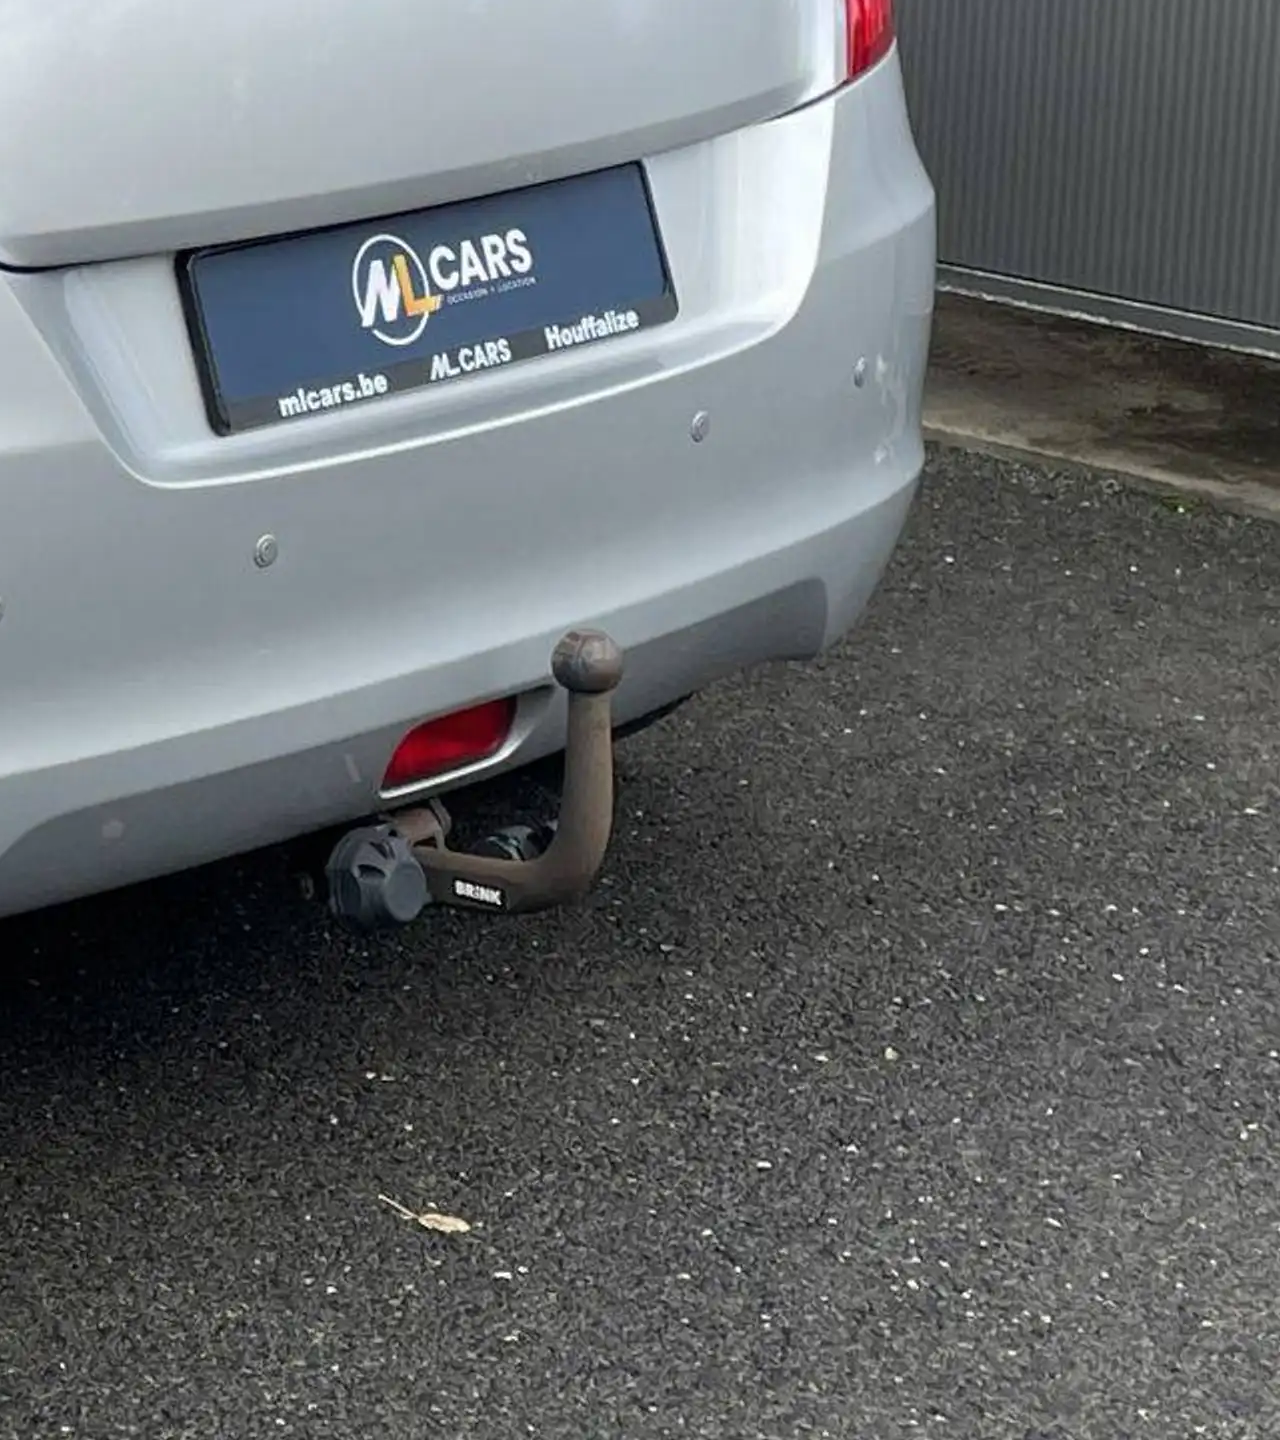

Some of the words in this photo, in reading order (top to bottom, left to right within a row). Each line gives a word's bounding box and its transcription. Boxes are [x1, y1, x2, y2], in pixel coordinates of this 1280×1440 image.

[361, 254, 443, 328] ML
[429, 228, 533, 291] CARS
[446, 289, 488, 306] OCCASION
[497, 276, 537, 294] LOCATION
[278, 372, 389, 418] mlcars.be
[458, 337, 512, 375] CARS
[545, 308, 640, 351] Houffalize
